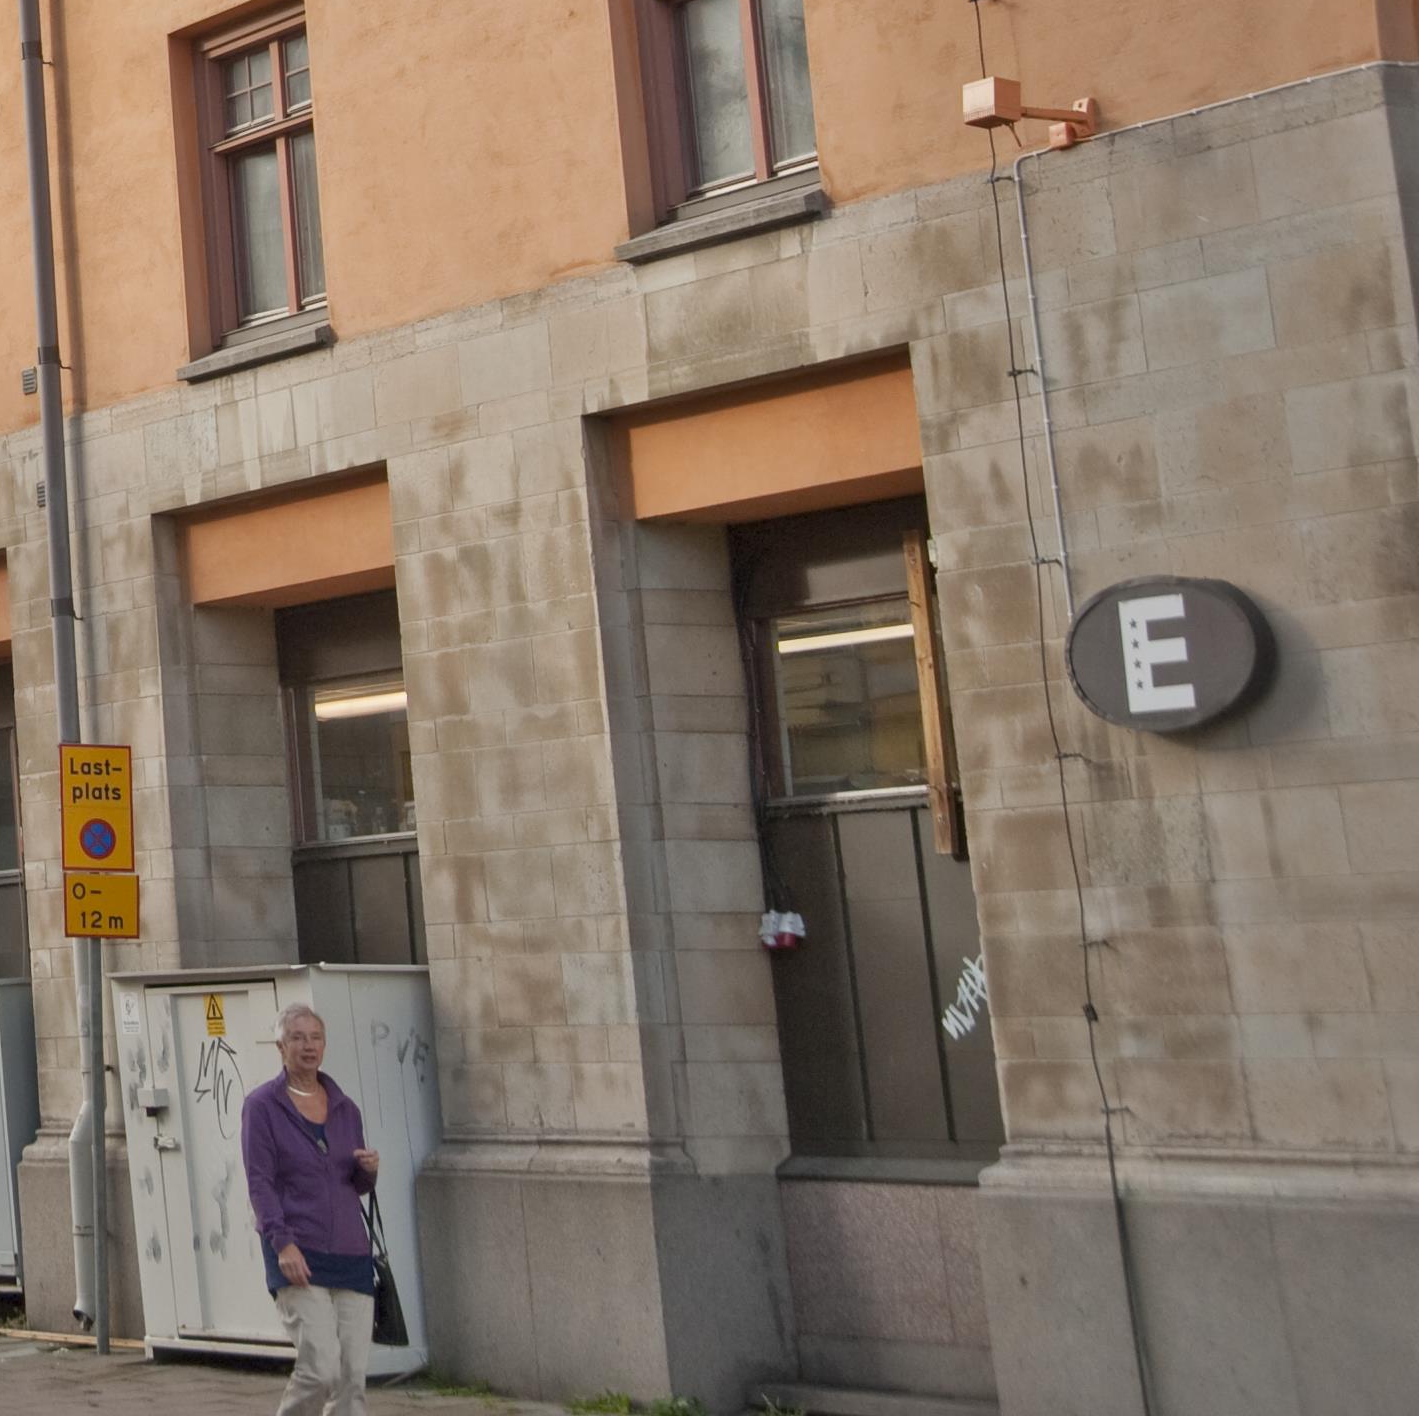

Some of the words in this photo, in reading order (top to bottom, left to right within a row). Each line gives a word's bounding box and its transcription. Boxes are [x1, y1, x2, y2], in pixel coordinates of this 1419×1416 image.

[1118, 593, 1197, 714] E
[69, 757, 123, 776] Last-
[72, 782, 122, 804] plats
[80, 910, 103, 929] 12
[108, 914, 124, 930] m
